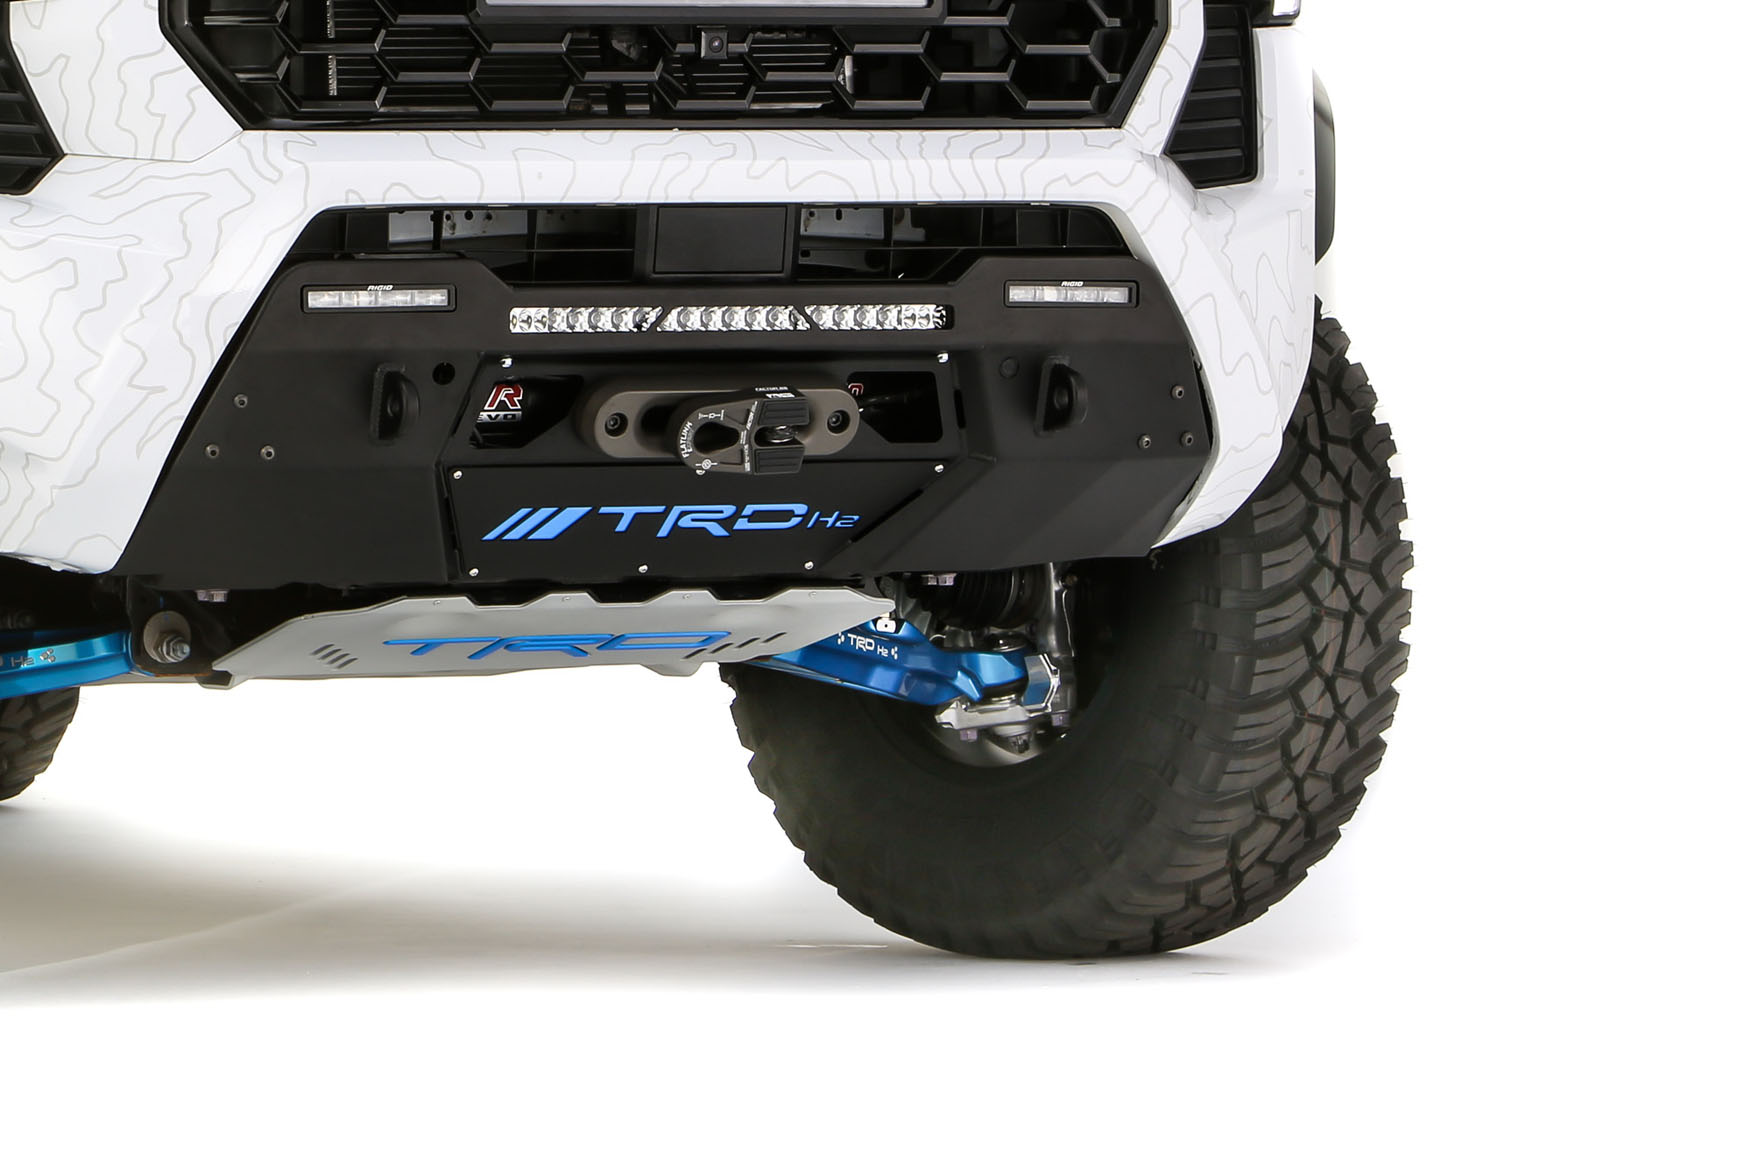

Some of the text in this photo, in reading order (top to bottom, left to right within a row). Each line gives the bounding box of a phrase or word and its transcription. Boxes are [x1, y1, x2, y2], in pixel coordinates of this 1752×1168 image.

[597, 504, 809, 538] TRD
[382, 631, 732, 660] TRD
[847, 633, 875, 652] TRD
